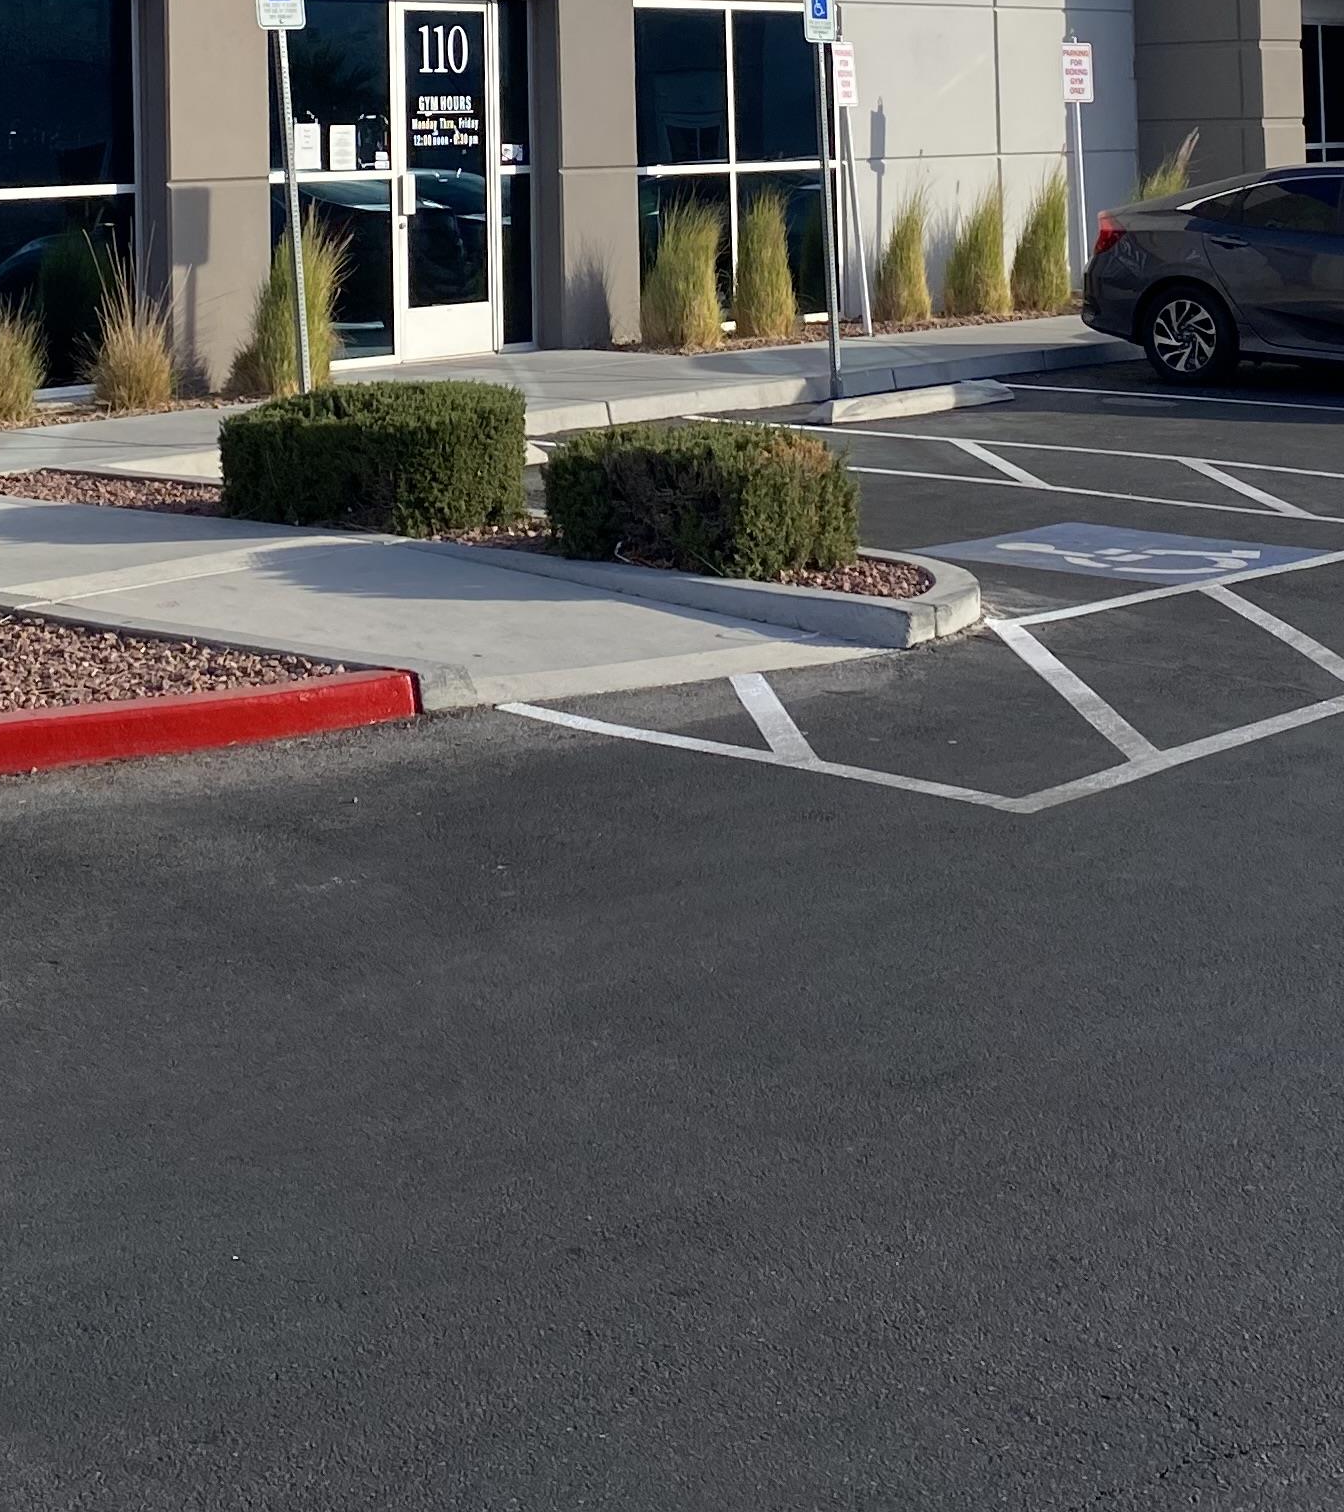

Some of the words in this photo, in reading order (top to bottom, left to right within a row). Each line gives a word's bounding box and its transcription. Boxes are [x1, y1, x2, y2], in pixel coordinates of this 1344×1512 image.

[418, 25, 468, 74] 110
[418, 96, 439, 111] GYM
[440, 96, 472, 111] HOURS
[413, 134, 432, 146] 12:00
